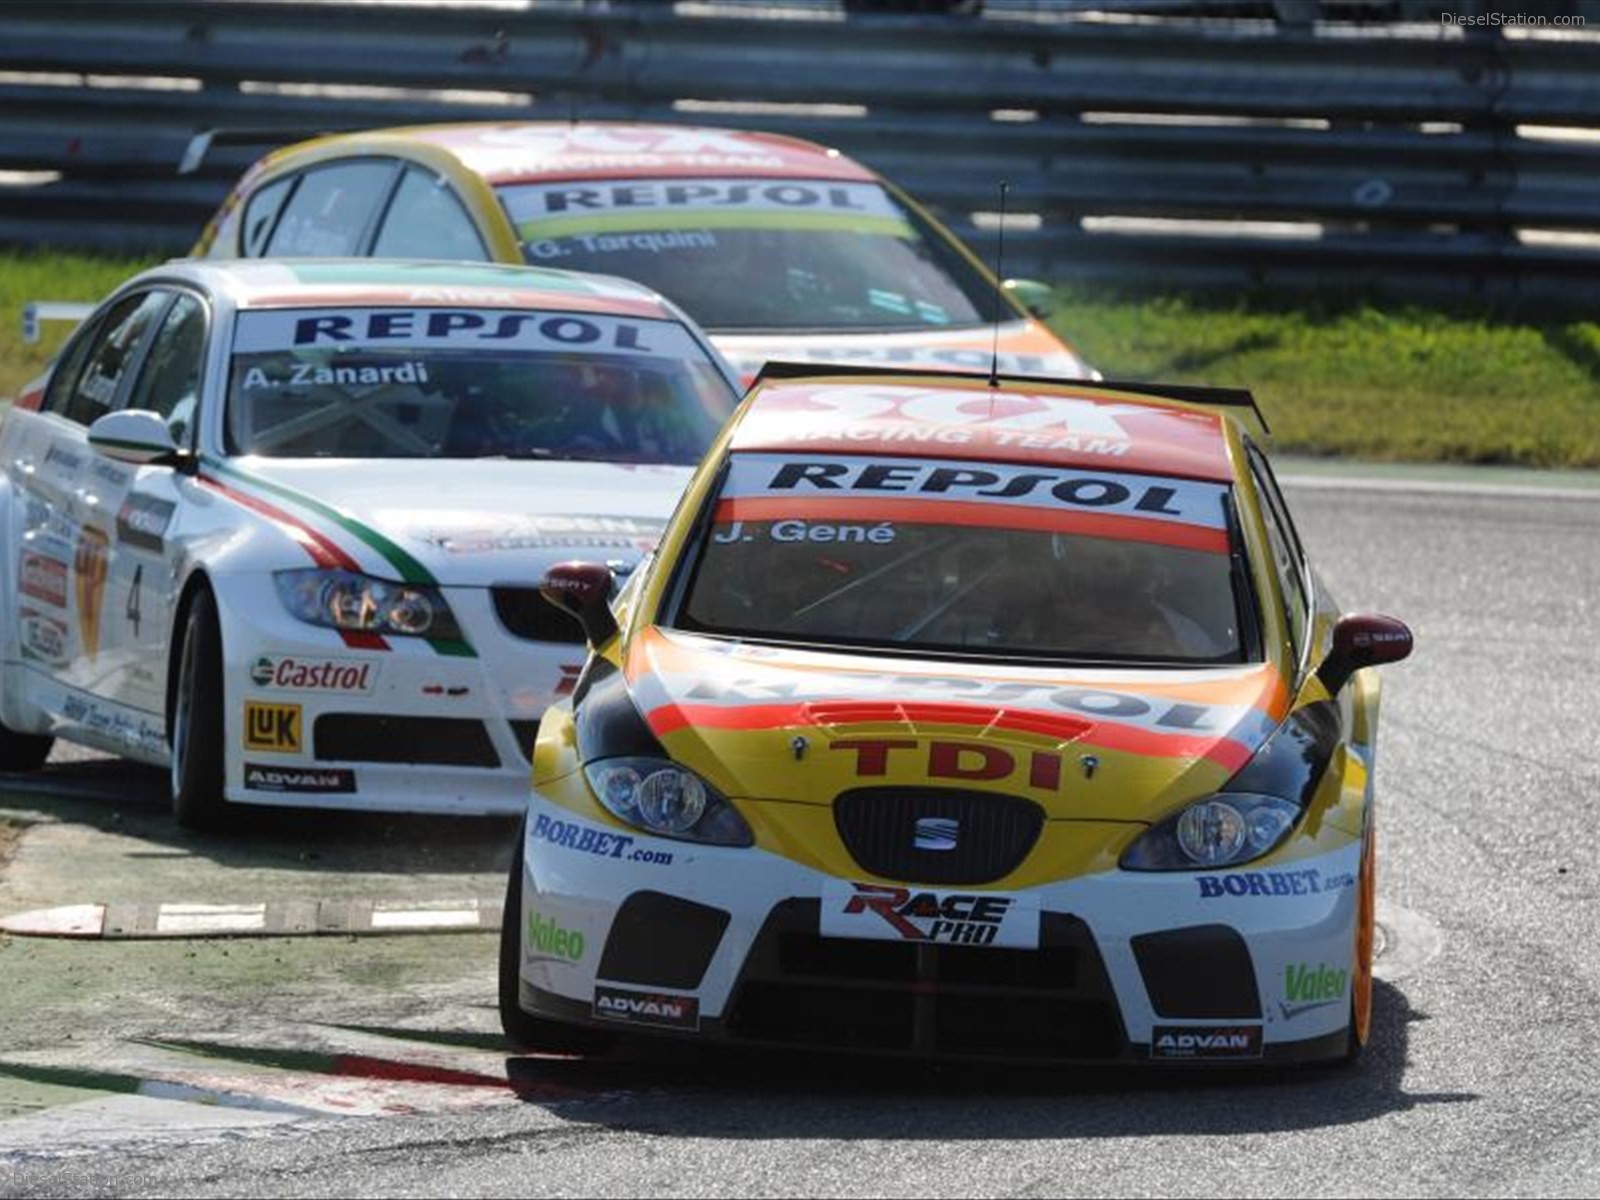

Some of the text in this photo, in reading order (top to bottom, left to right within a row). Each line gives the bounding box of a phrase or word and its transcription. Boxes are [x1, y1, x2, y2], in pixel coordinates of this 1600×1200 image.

[544, 184, 866, 213] REPSOL
[530, 228, 718, 259] G. Tarquini
[293, 311, 652, 352] REPSOL
[243, 361, 429, 389] A. Zanardi
[995, 431, 1131, 457] TEAM
[768, 461, 1182, 516] REPSOL
[714, 519, 896, 544] J. Gené
[276, 658, 370, 690] Castrol
[685, 670, 1213, 730] PSOL
[248, 770, 341, 787] ADVAN
[829, 740, 1063, 792] TDI
[842, 881, 1016, 940] RACE
[528, 909, 585, 961] Valeo
[928, 920, 999, 945] PRO
[1285, 961, 1347, 1002] Valeo
[597, 995, 683, 1018] ADVAN
[1156, 1034, 1249, 1049] ADVAN
